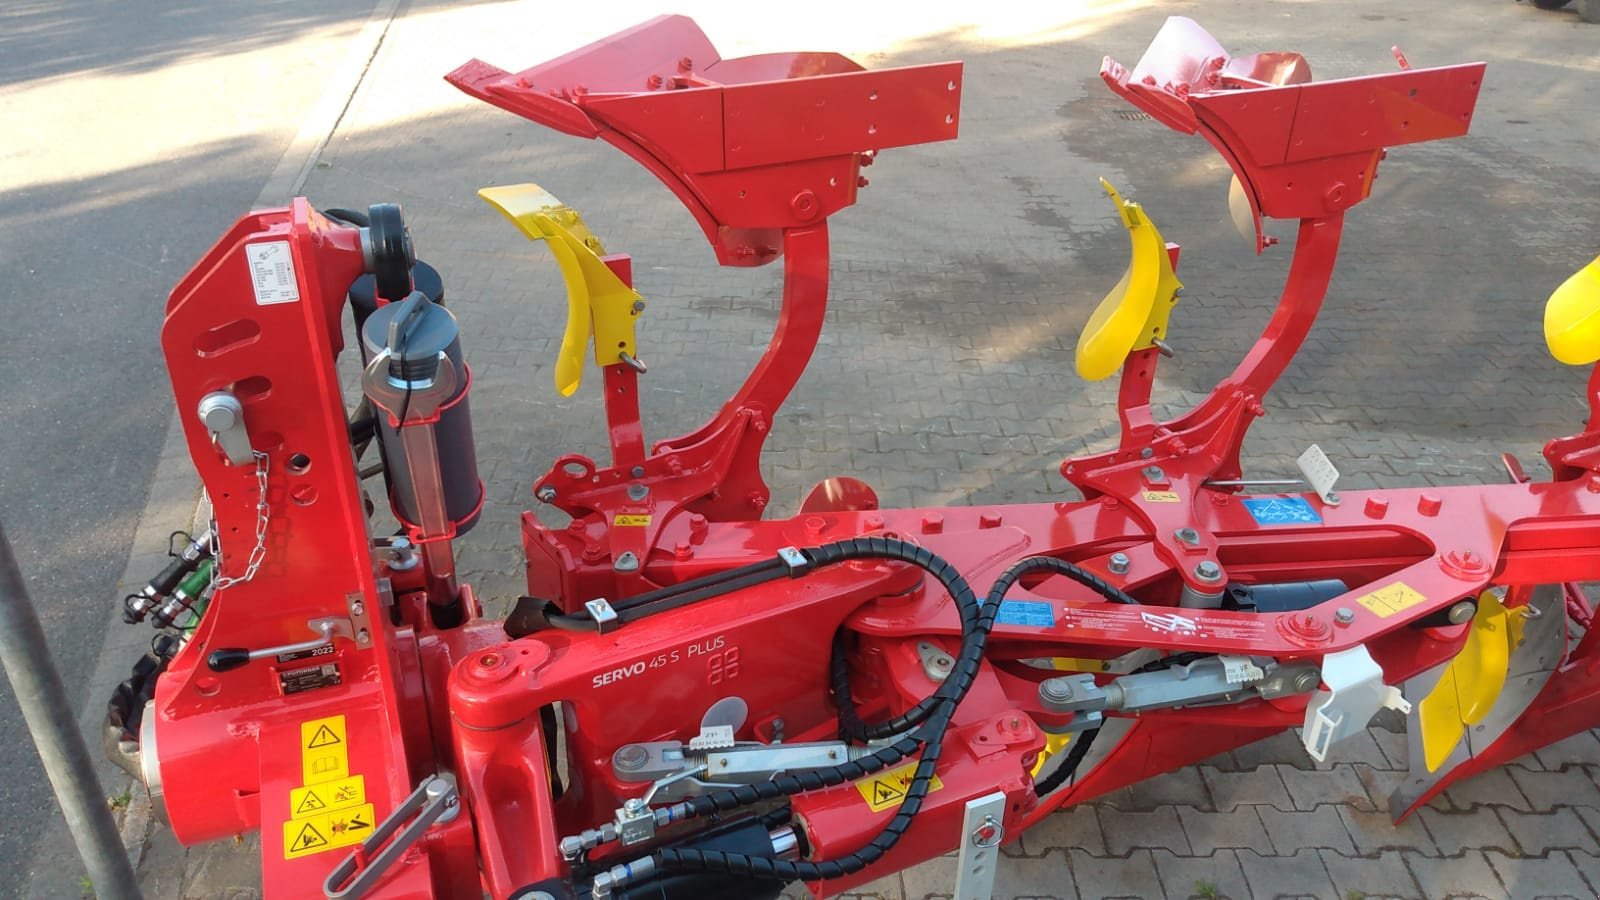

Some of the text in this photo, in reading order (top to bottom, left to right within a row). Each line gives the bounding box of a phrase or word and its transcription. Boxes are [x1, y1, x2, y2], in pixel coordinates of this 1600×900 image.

[312, 646, 334, 656] 2022
[593, 635, 725, 688] SERVO 45 S PLUS
